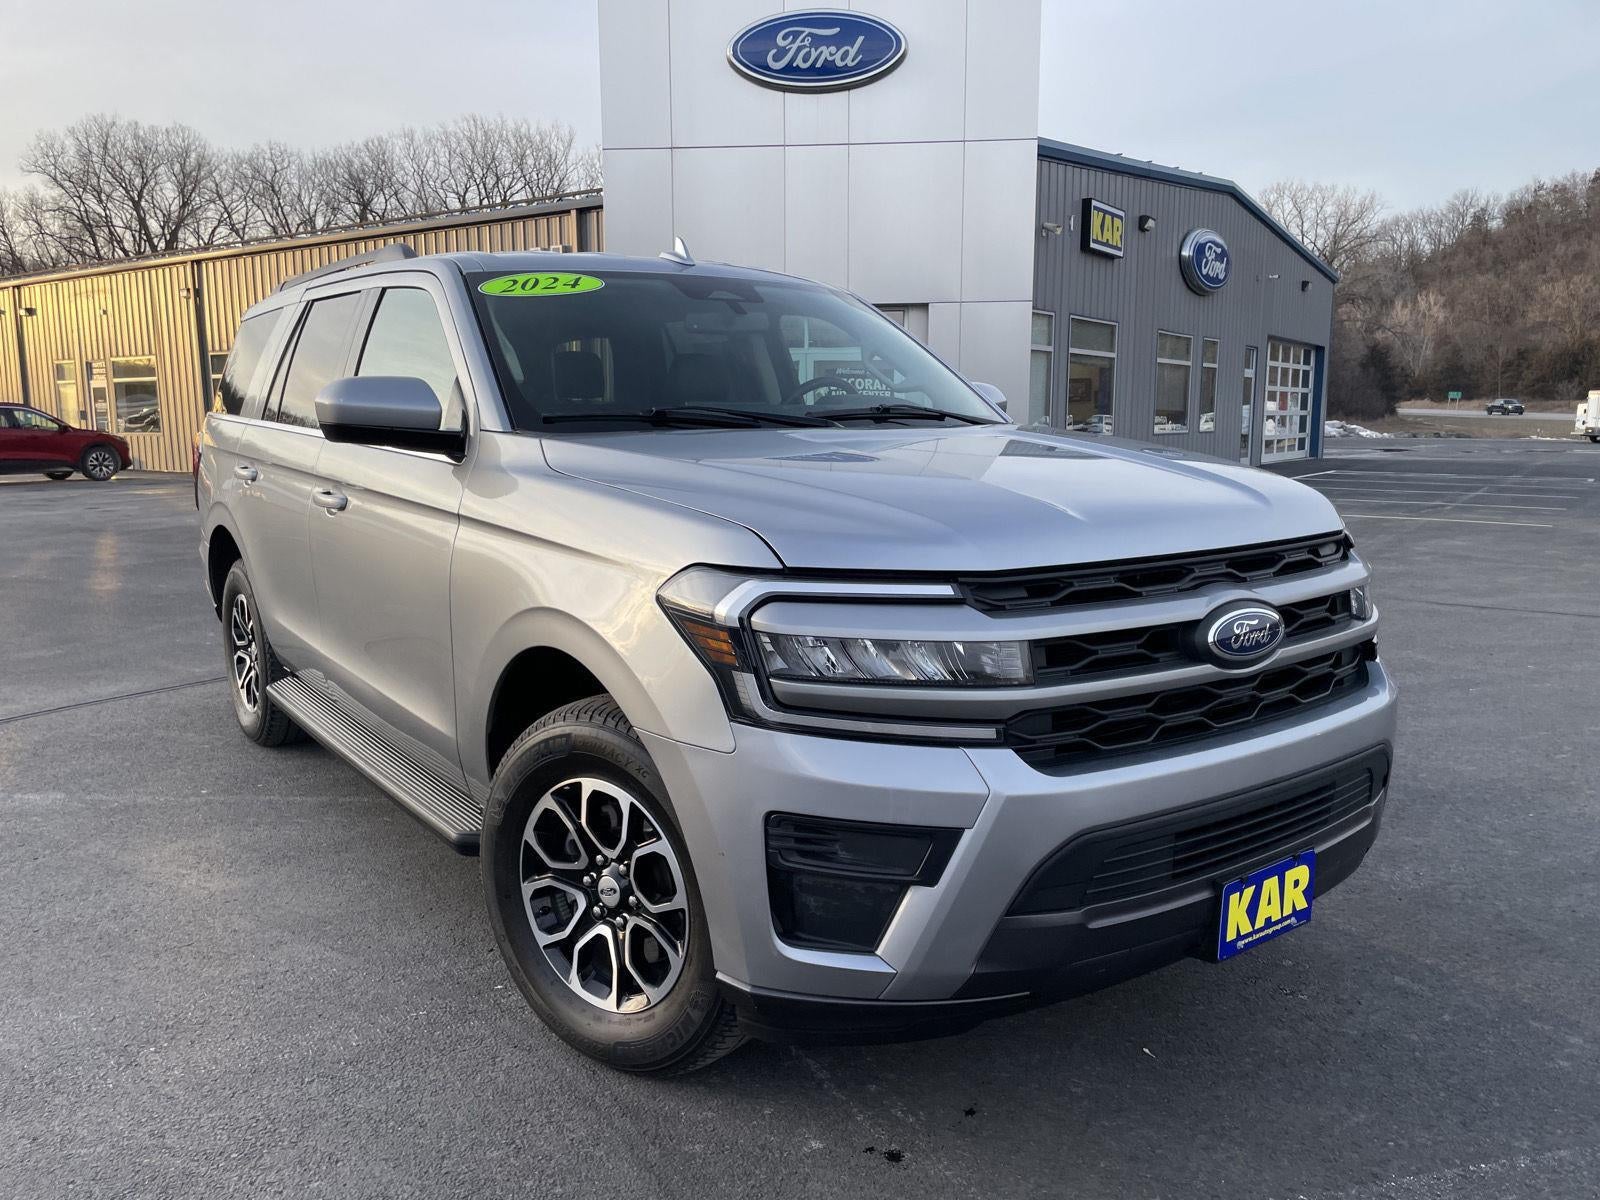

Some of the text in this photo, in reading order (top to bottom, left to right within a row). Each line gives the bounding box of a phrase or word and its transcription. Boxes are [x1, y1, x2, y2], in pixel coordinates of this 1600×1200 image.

[767, 27, 864, 70] Ford
[1092, 210, 1123, 248] KAR
[1202, 242, 1227, 280] Ford
[501, 276, 582, 294] 2024
[1231, 619, 1271, 649] Ford
[1226, 864, 1310, 943] KAR
